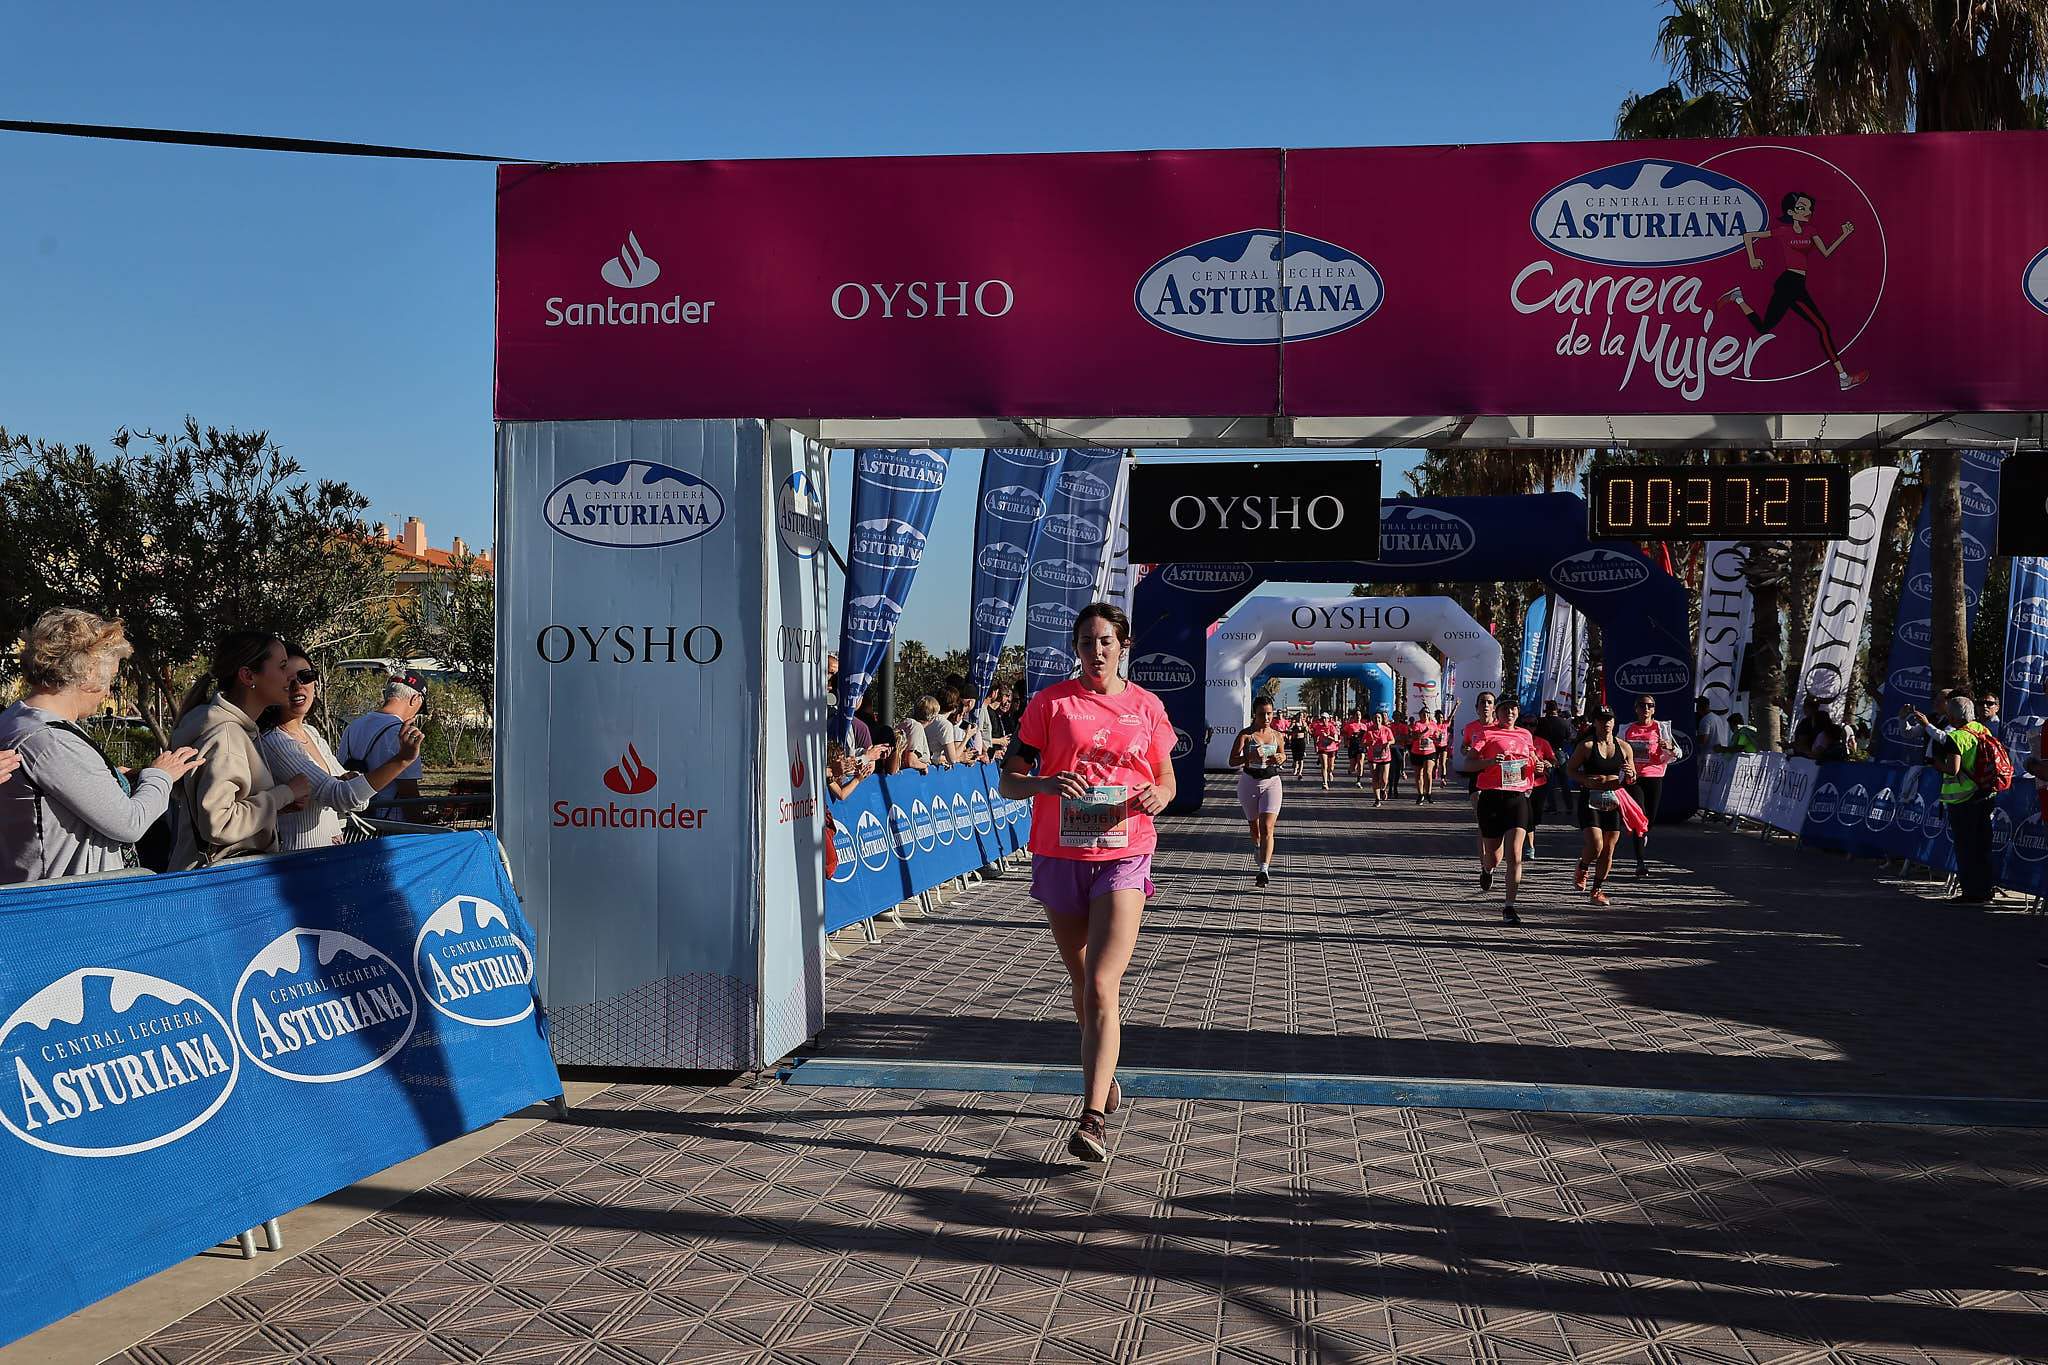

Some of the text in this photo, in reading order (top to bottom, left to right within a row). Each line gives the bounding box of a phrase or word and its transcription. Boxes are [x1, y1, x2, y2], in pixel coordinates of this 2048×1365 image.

[1585, 194, 1743, 208] CENTRAL LECHERA
[1549, 200, 1748, 240] ASTURIANA
[1192, 269, 1269, 281] CENTRAL
[1510, 260, 1703, 316] Carrera
[830, 279, 1015, 321] OYSHO
[1154, 274, 1365, 316] ASTURIANA
[545, 295, 716, 327] Santander
[1556, 310, 1777, 401] de la Mujer
[859, 452, 944, 486] ASTURIANA
[557, 493, 711, 527] ASTURIANA
[585, 490, 706, 500] CENTRAL LECHERA
[1608, 478, 1829, 527] 00:37:27
[1169, 495, 1345, 531] OYSHO
[1381, 533, 1465, 551] URIANA
[1167, 565, 1246, 582] ASTURIANA
[1559, 567, 1644, 583] ASTURIANA
[1028, 609, 1076, 628] ASTURIAN
[1291, 606, 1411, 630] OYSHO
[1804, 502, 1876, 705] OYSHO
[536, 624, 724, 664] OYSHO
[777, 624, 822, 666] OYSHO
[1221, 632, 1257, 641] OYSHO
[1444, 631, 1481, 640] OYSHO
[1130, 666, 1191, 684] ASTURIANA
[1205, 680, 1238, 688] OYSHO
[1462, 680, 1496, 689] OYSHO
[1620, 669, 1687, 685] ASTURIANA
[1210, 726, 1237, 735] YSHO
[553, 800, 709, 830] Santander
[779, 793, 818, 824] Santander
[442, 938, 487, 958] CENTRAL
[269, 963, 386, 1004] CENTRAL LECHERA
[428, 952, 525, 1004] ASTURIAN
[41, 1009, 203, 1062] CENTRAL LECHERA
[250, 981, 411, 1060] ASTURIANA
[15, 1033, 230, 1131] ASTURIANA
